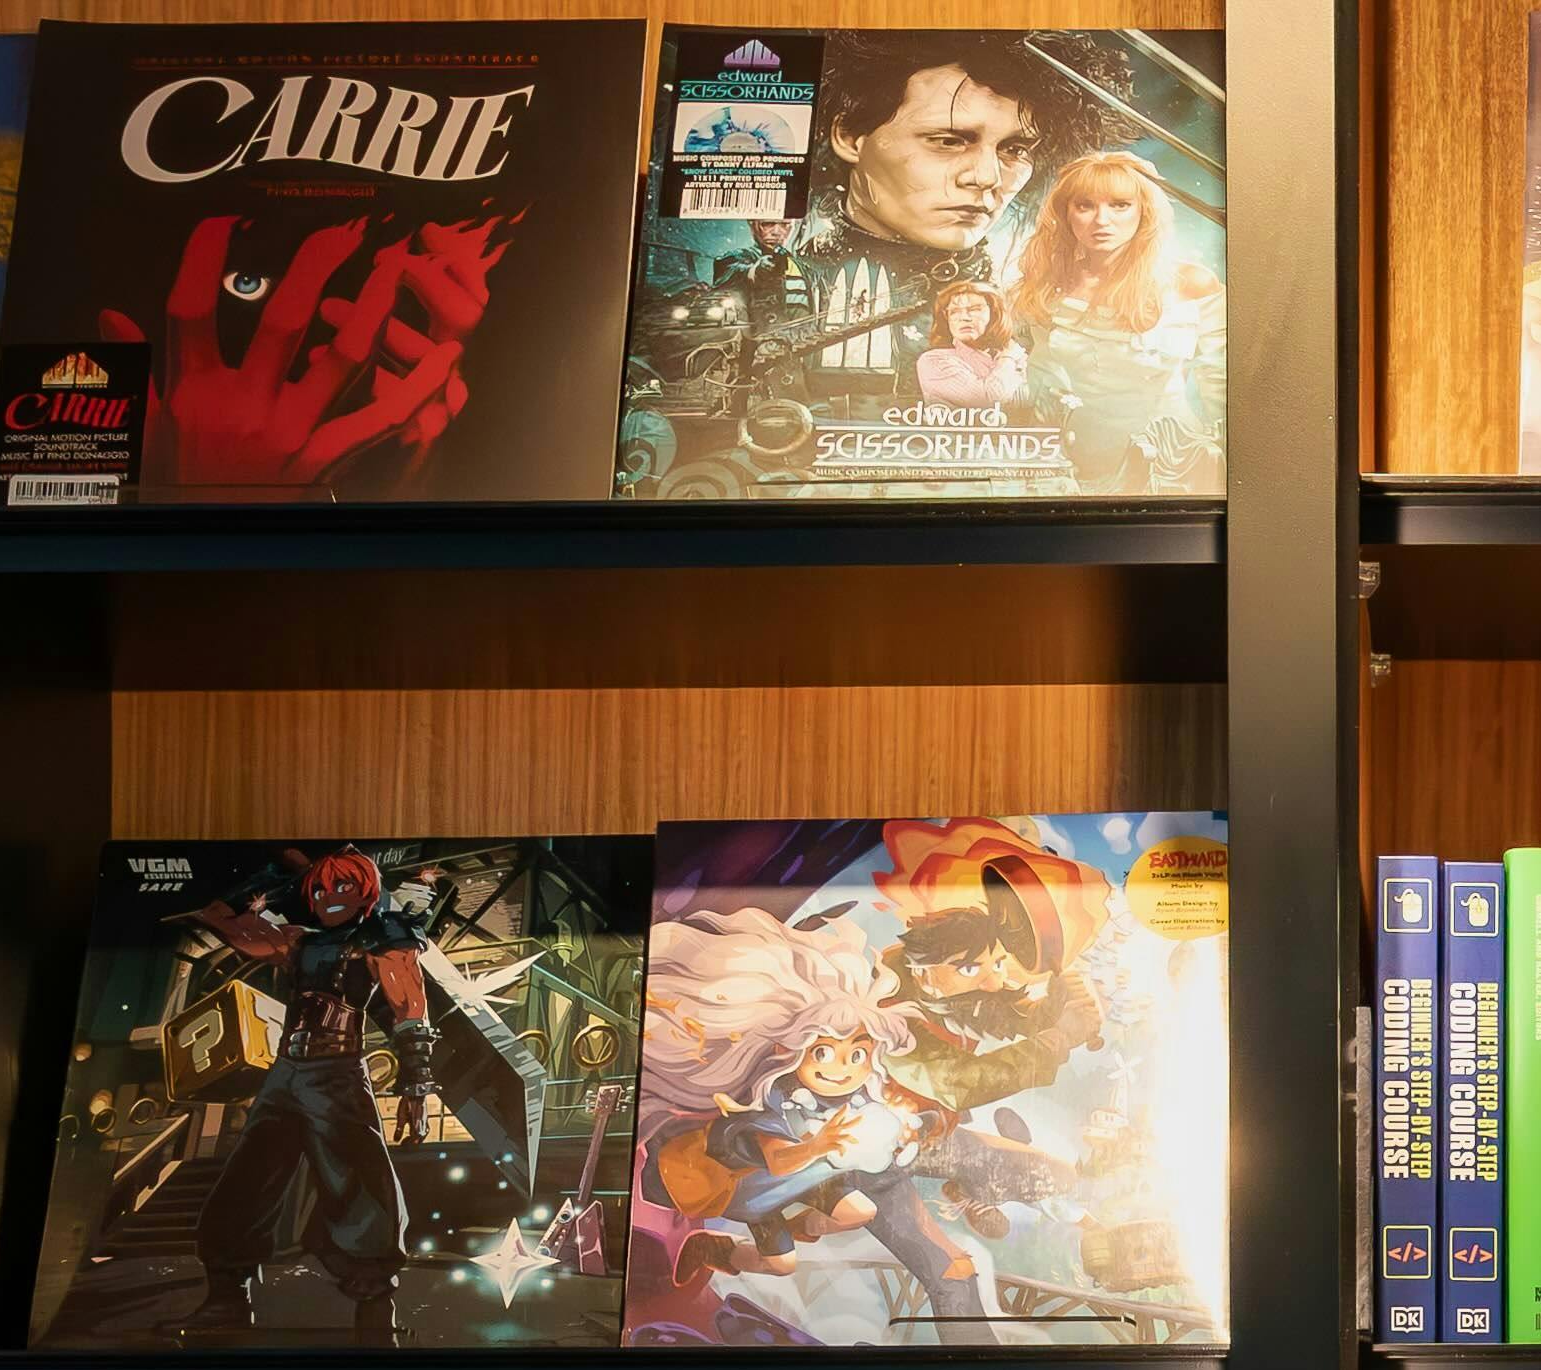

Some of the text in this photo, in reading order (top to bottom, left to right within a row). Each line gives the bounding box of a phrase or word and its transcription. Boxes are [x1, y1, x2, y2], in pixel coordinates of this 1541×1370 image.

[717, 69, 782, 83] edward
[680, 84, 814, 101] SCISSORHANDS
[121, 75, 536, 183] CARRIE
[883, 402, 1007, 426] edward
[816, 433, 1060, 461] SCISSORHANDS
[1149, 851, 1227, 870] EASTWARD
[1449, 982, 1476, 1181] CODING COURSE
[1477, 982, 1499, 1182] BEGINNER'S STEP-BY-STEP
[1461, 1311, 1486, 1329] DK
